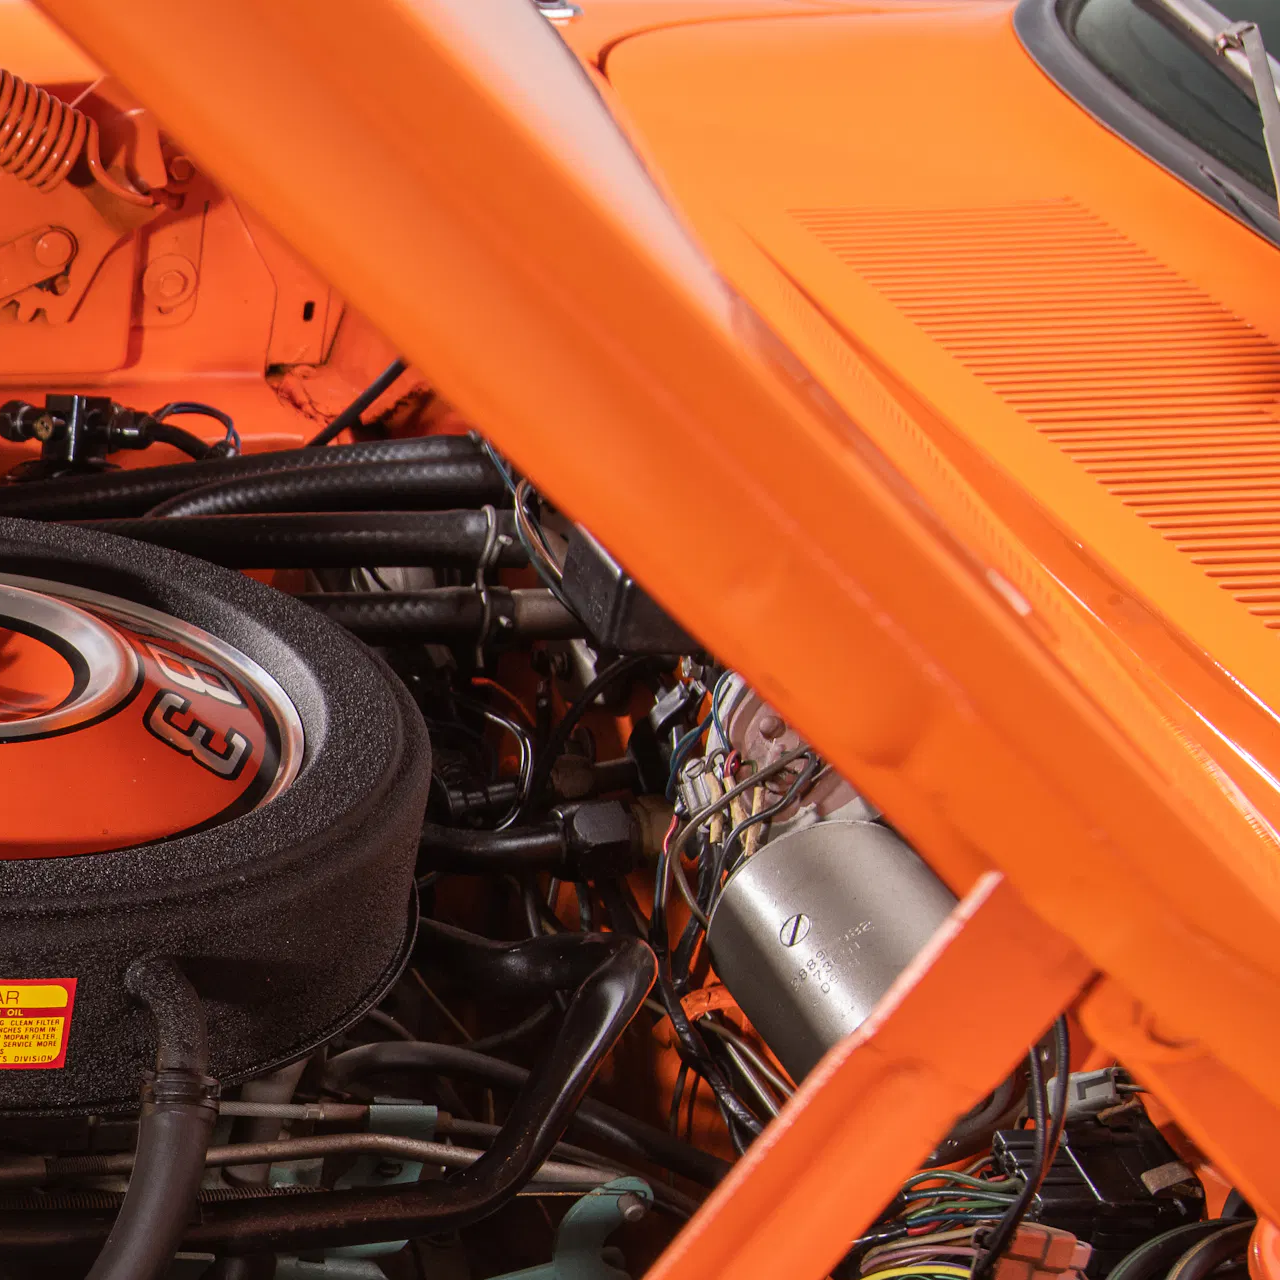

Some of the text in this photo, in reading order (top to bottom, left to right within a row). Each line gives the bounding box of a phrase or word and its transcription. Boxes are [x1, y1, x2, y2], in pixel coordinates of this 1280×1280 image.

[6, 1008, 24, 1016] OIL
[10, 1017, 33, 1027] CLEAN
[35, 1017, 60, 1027] FILTER
[24, 1026, 45, 1034] FROM
[3, 1032, 29, 1041] MOPAR
[2, 1039, 32, 1049] SERVICE
[36, 1039, 57, 1048] MORE
[13, 1052, 53, 1064] DIVISION
